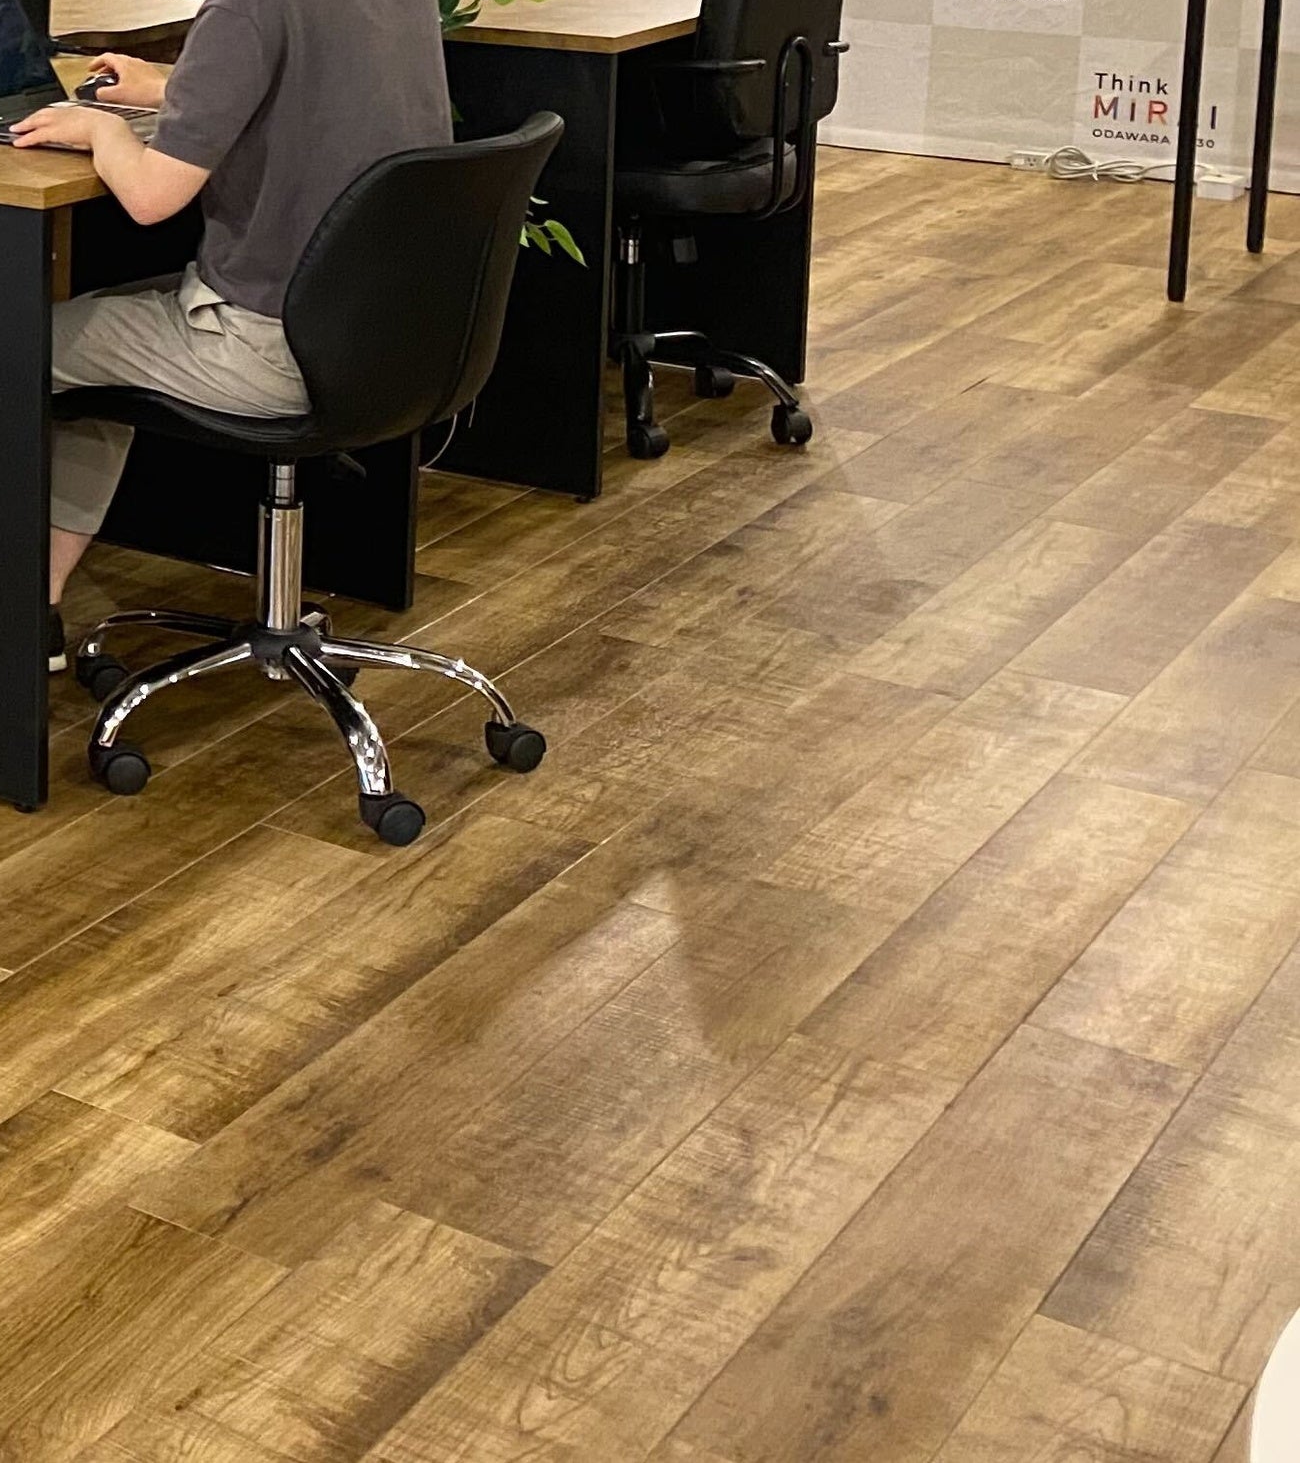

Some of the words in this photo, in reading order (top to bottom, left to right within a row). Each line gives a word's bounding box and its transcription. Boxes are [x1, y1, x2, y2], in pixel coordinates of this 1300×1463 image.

[1094, 73, 1168, 95] Think
[1093, 95, 1217, 130] MIRI
[1092, 129, 1171, 144] ODAWARA
